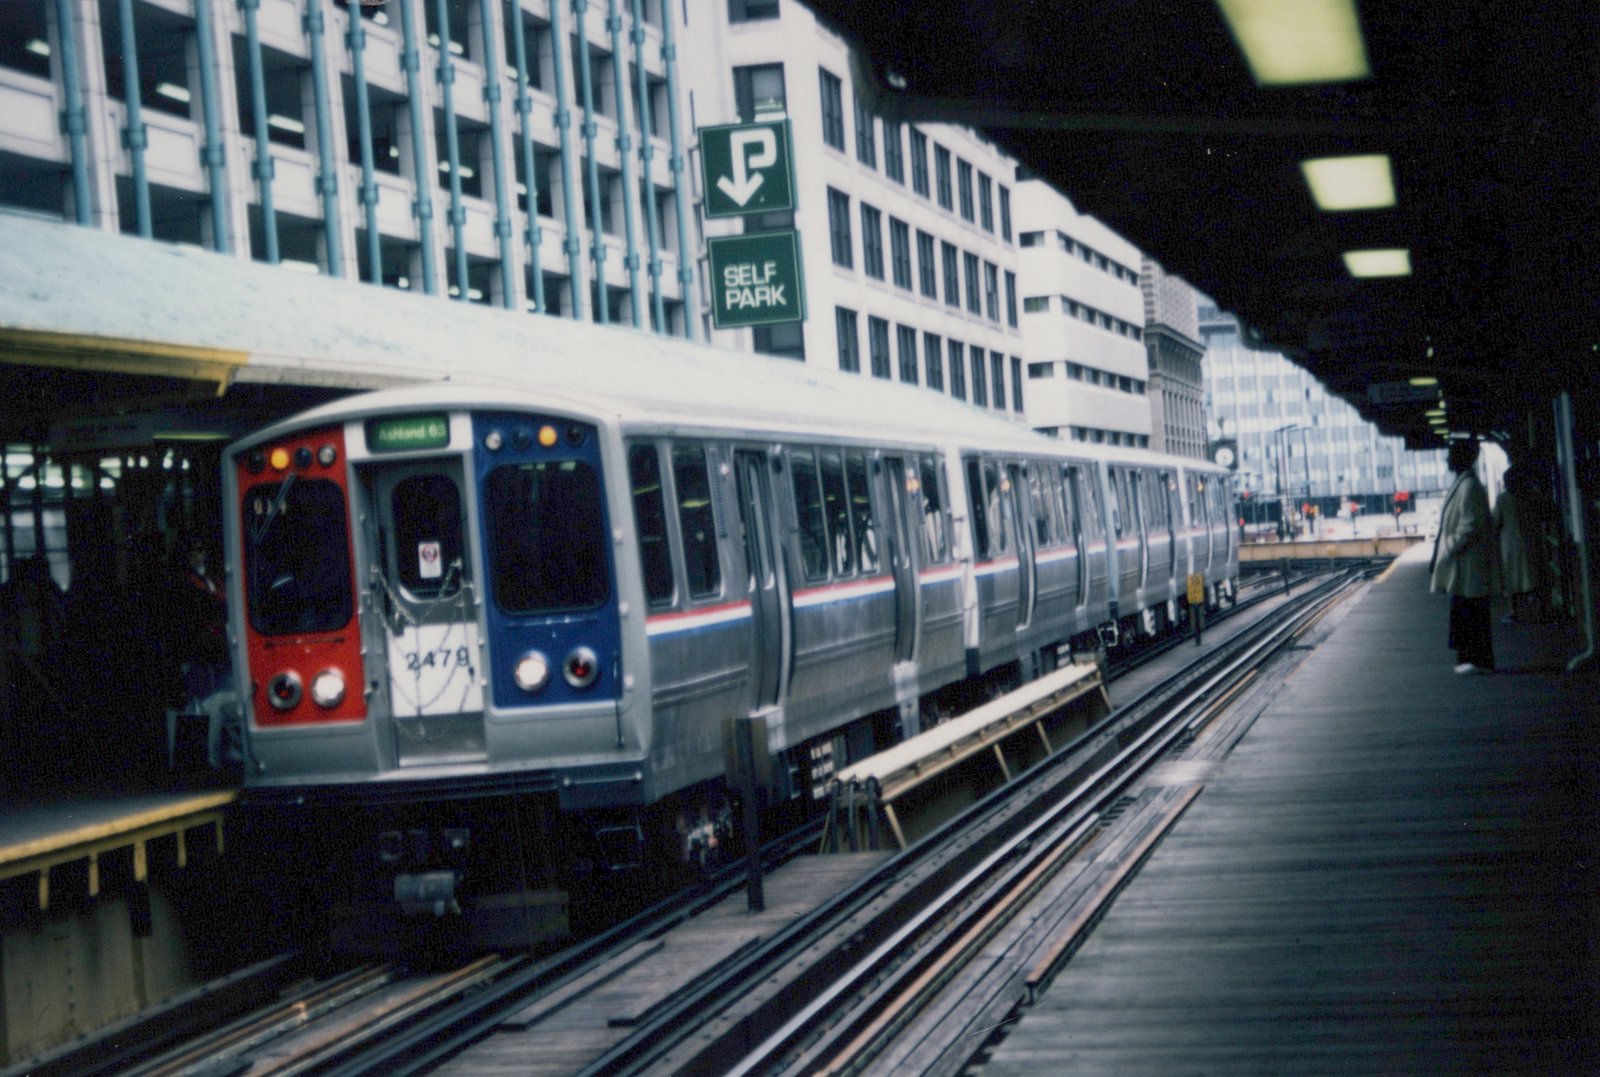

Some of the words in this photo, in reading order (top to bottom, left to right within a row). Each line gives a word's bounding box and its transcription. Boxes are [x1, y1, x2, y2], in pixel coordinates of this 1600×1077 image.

[723, 261, 777, 288] SELF
[725, 285, 787, 310] PARK
[379, 426, 425, 441] Ashland
